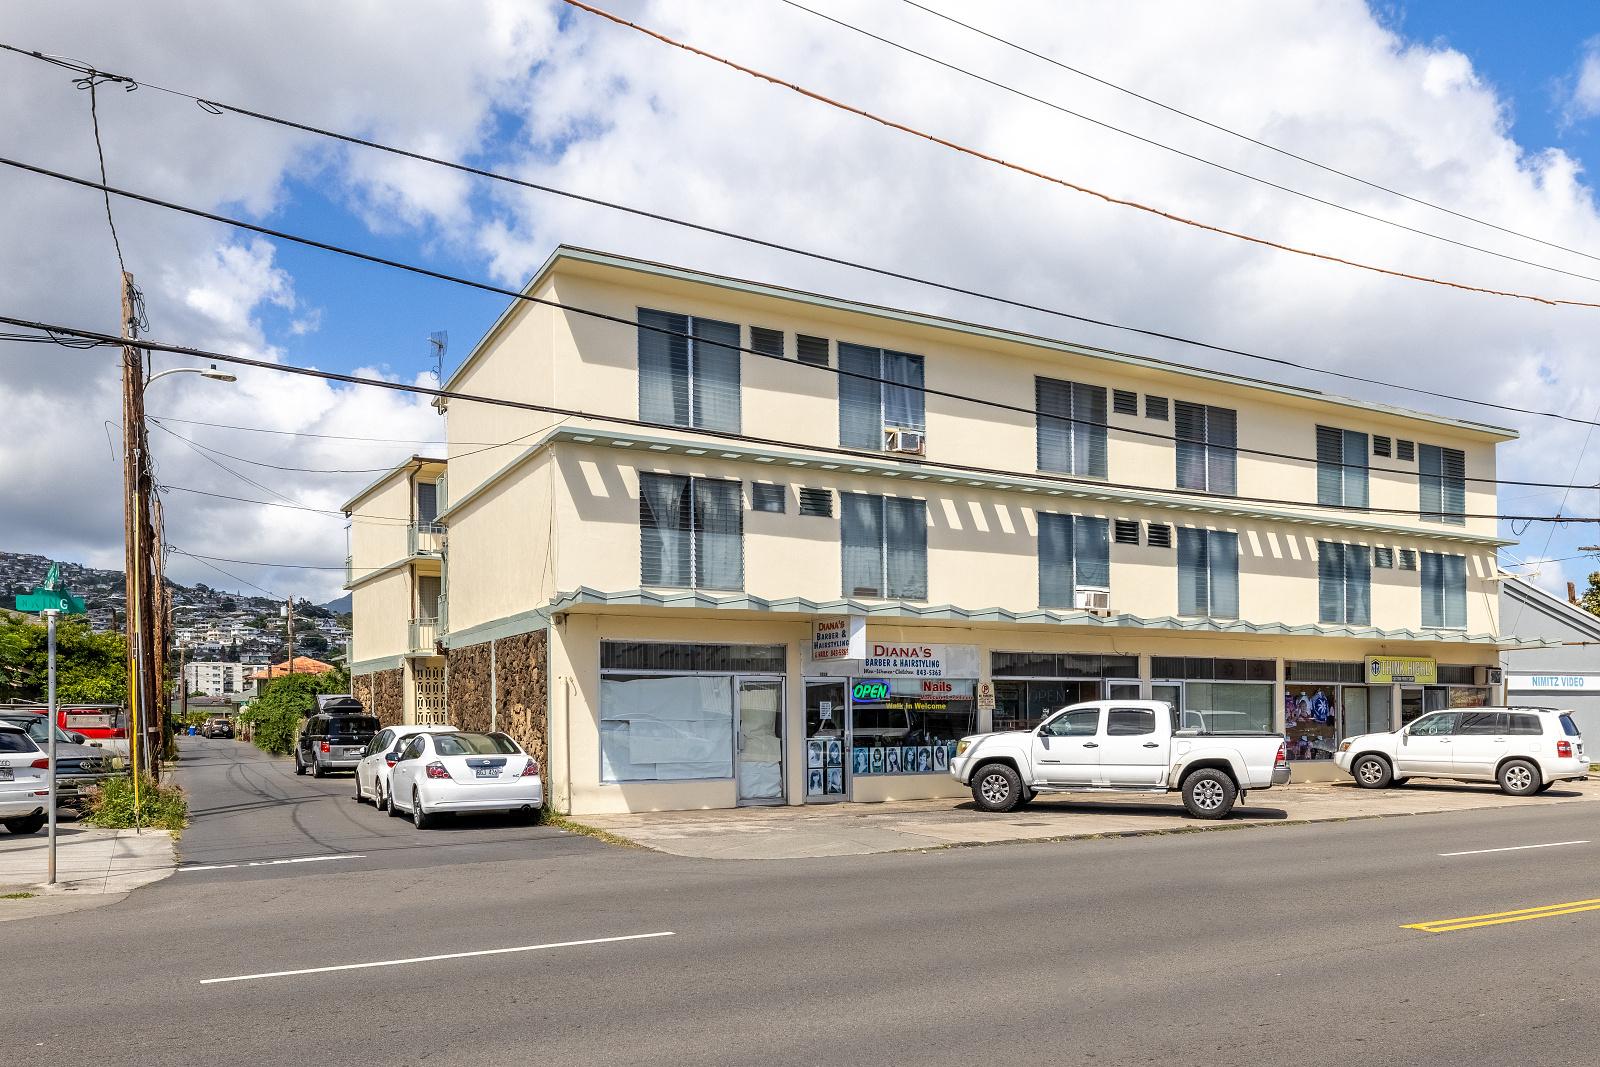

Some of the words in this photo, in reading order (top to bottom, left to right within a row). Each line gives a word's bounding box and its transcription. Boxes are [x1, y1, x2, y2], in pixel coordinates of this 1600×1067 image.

[32, 598, 68, 610] KING
[816, 632, 839, 641] BARBER
[841, 629, 847, 638] &
[813, 640, 850, 650] HAIRSTYLING
[874, 645, 932, 658] DIANA'S
[865, 658, 891, 667] BARBER
[892, 659, 898, 667] &
[899, 659, 940, 668] HAIRSTYLING
[1380, 660, 1406, 676] THINK
[1407, 660, 1435, 677] HIGHLY
[923, 681, 952, 692] Nails
[1532, 676, 1560, 687] NIMITZ
[1560, 677, 1584, 687] VIDEO
[853, 684, 887, 698] OPEN
[1028, 689, 1066, 702] OPEN
[914, 702, 947, 710] Welcome
